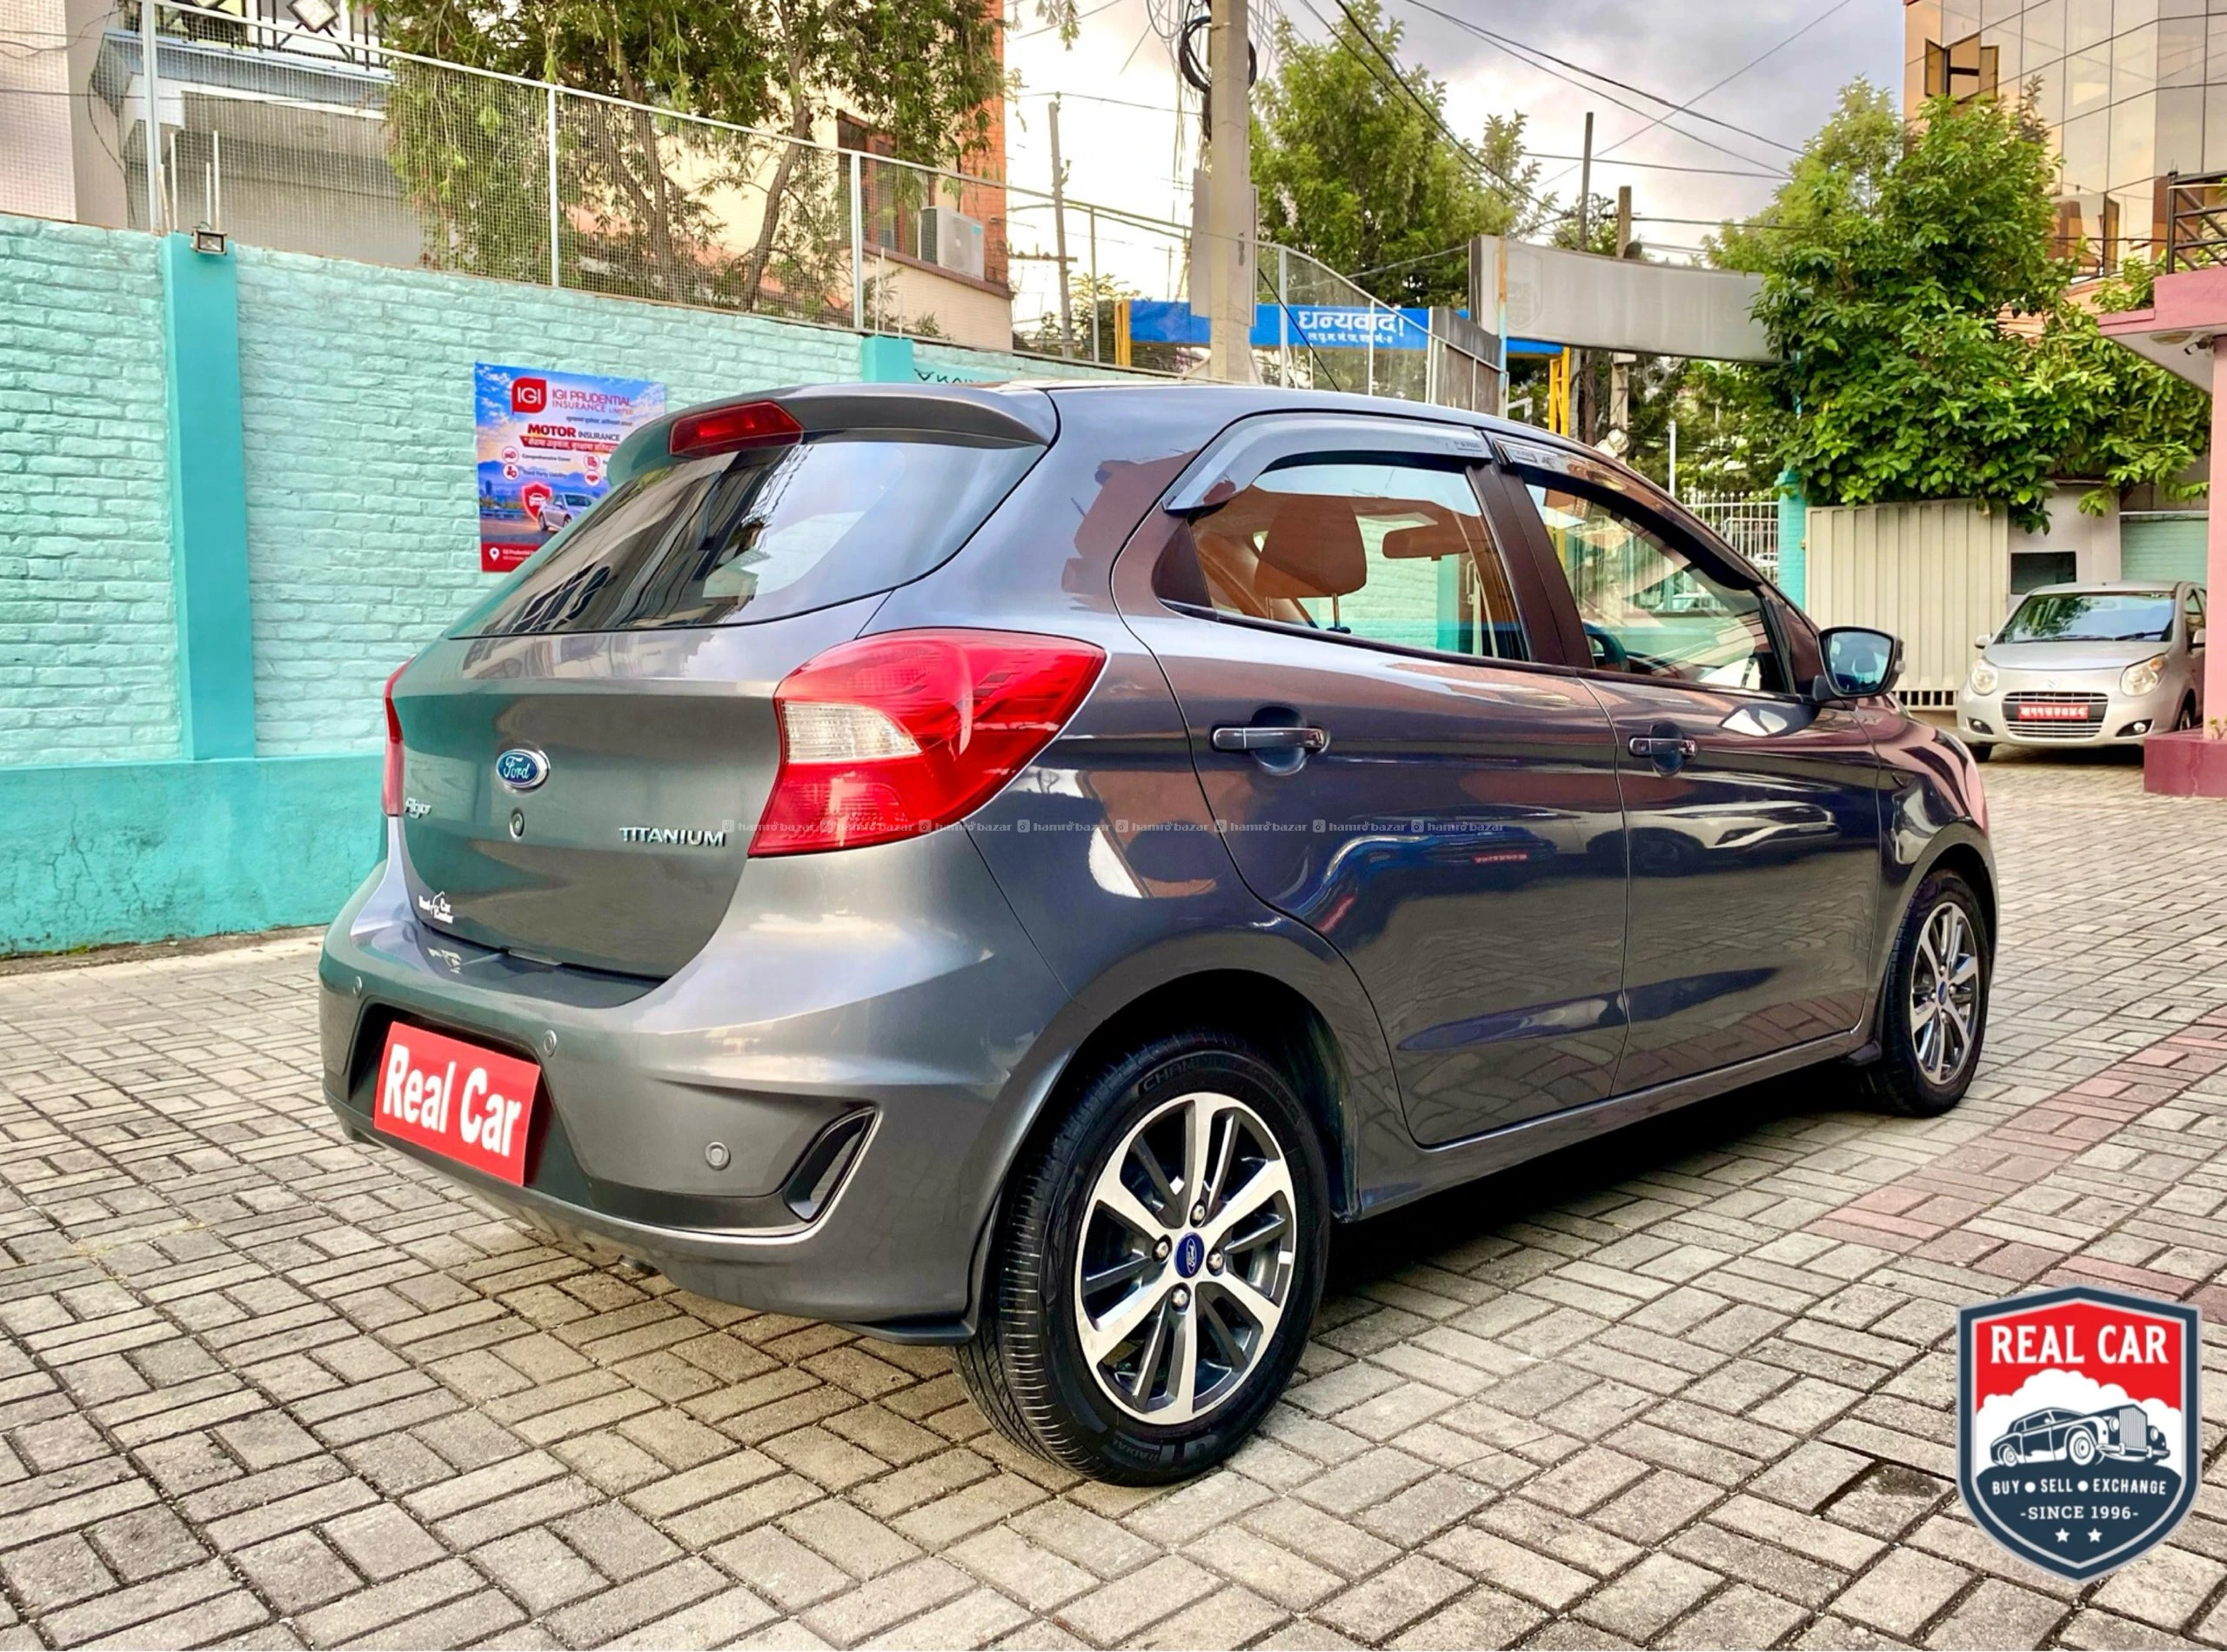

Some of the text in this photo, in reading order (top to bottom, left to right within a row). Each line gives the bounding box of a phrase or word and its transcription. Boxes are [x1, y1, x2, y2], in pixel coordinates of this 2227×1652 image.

[1298, 311, 1404, 337] धन्यवाद!
[517, 386, 541, 405] IGI
[552, 389, 632, 406] IGI PRUDENTIAL
[552, 400, 605, 413] INSURANCE
[527, 424, 620, 442] MOTOR INSURANCE
[502, 756, 532, 780] Ford
[619, 826, 726, 847] TITANIUM
[382, 1043, 522, 1158] Real Car
